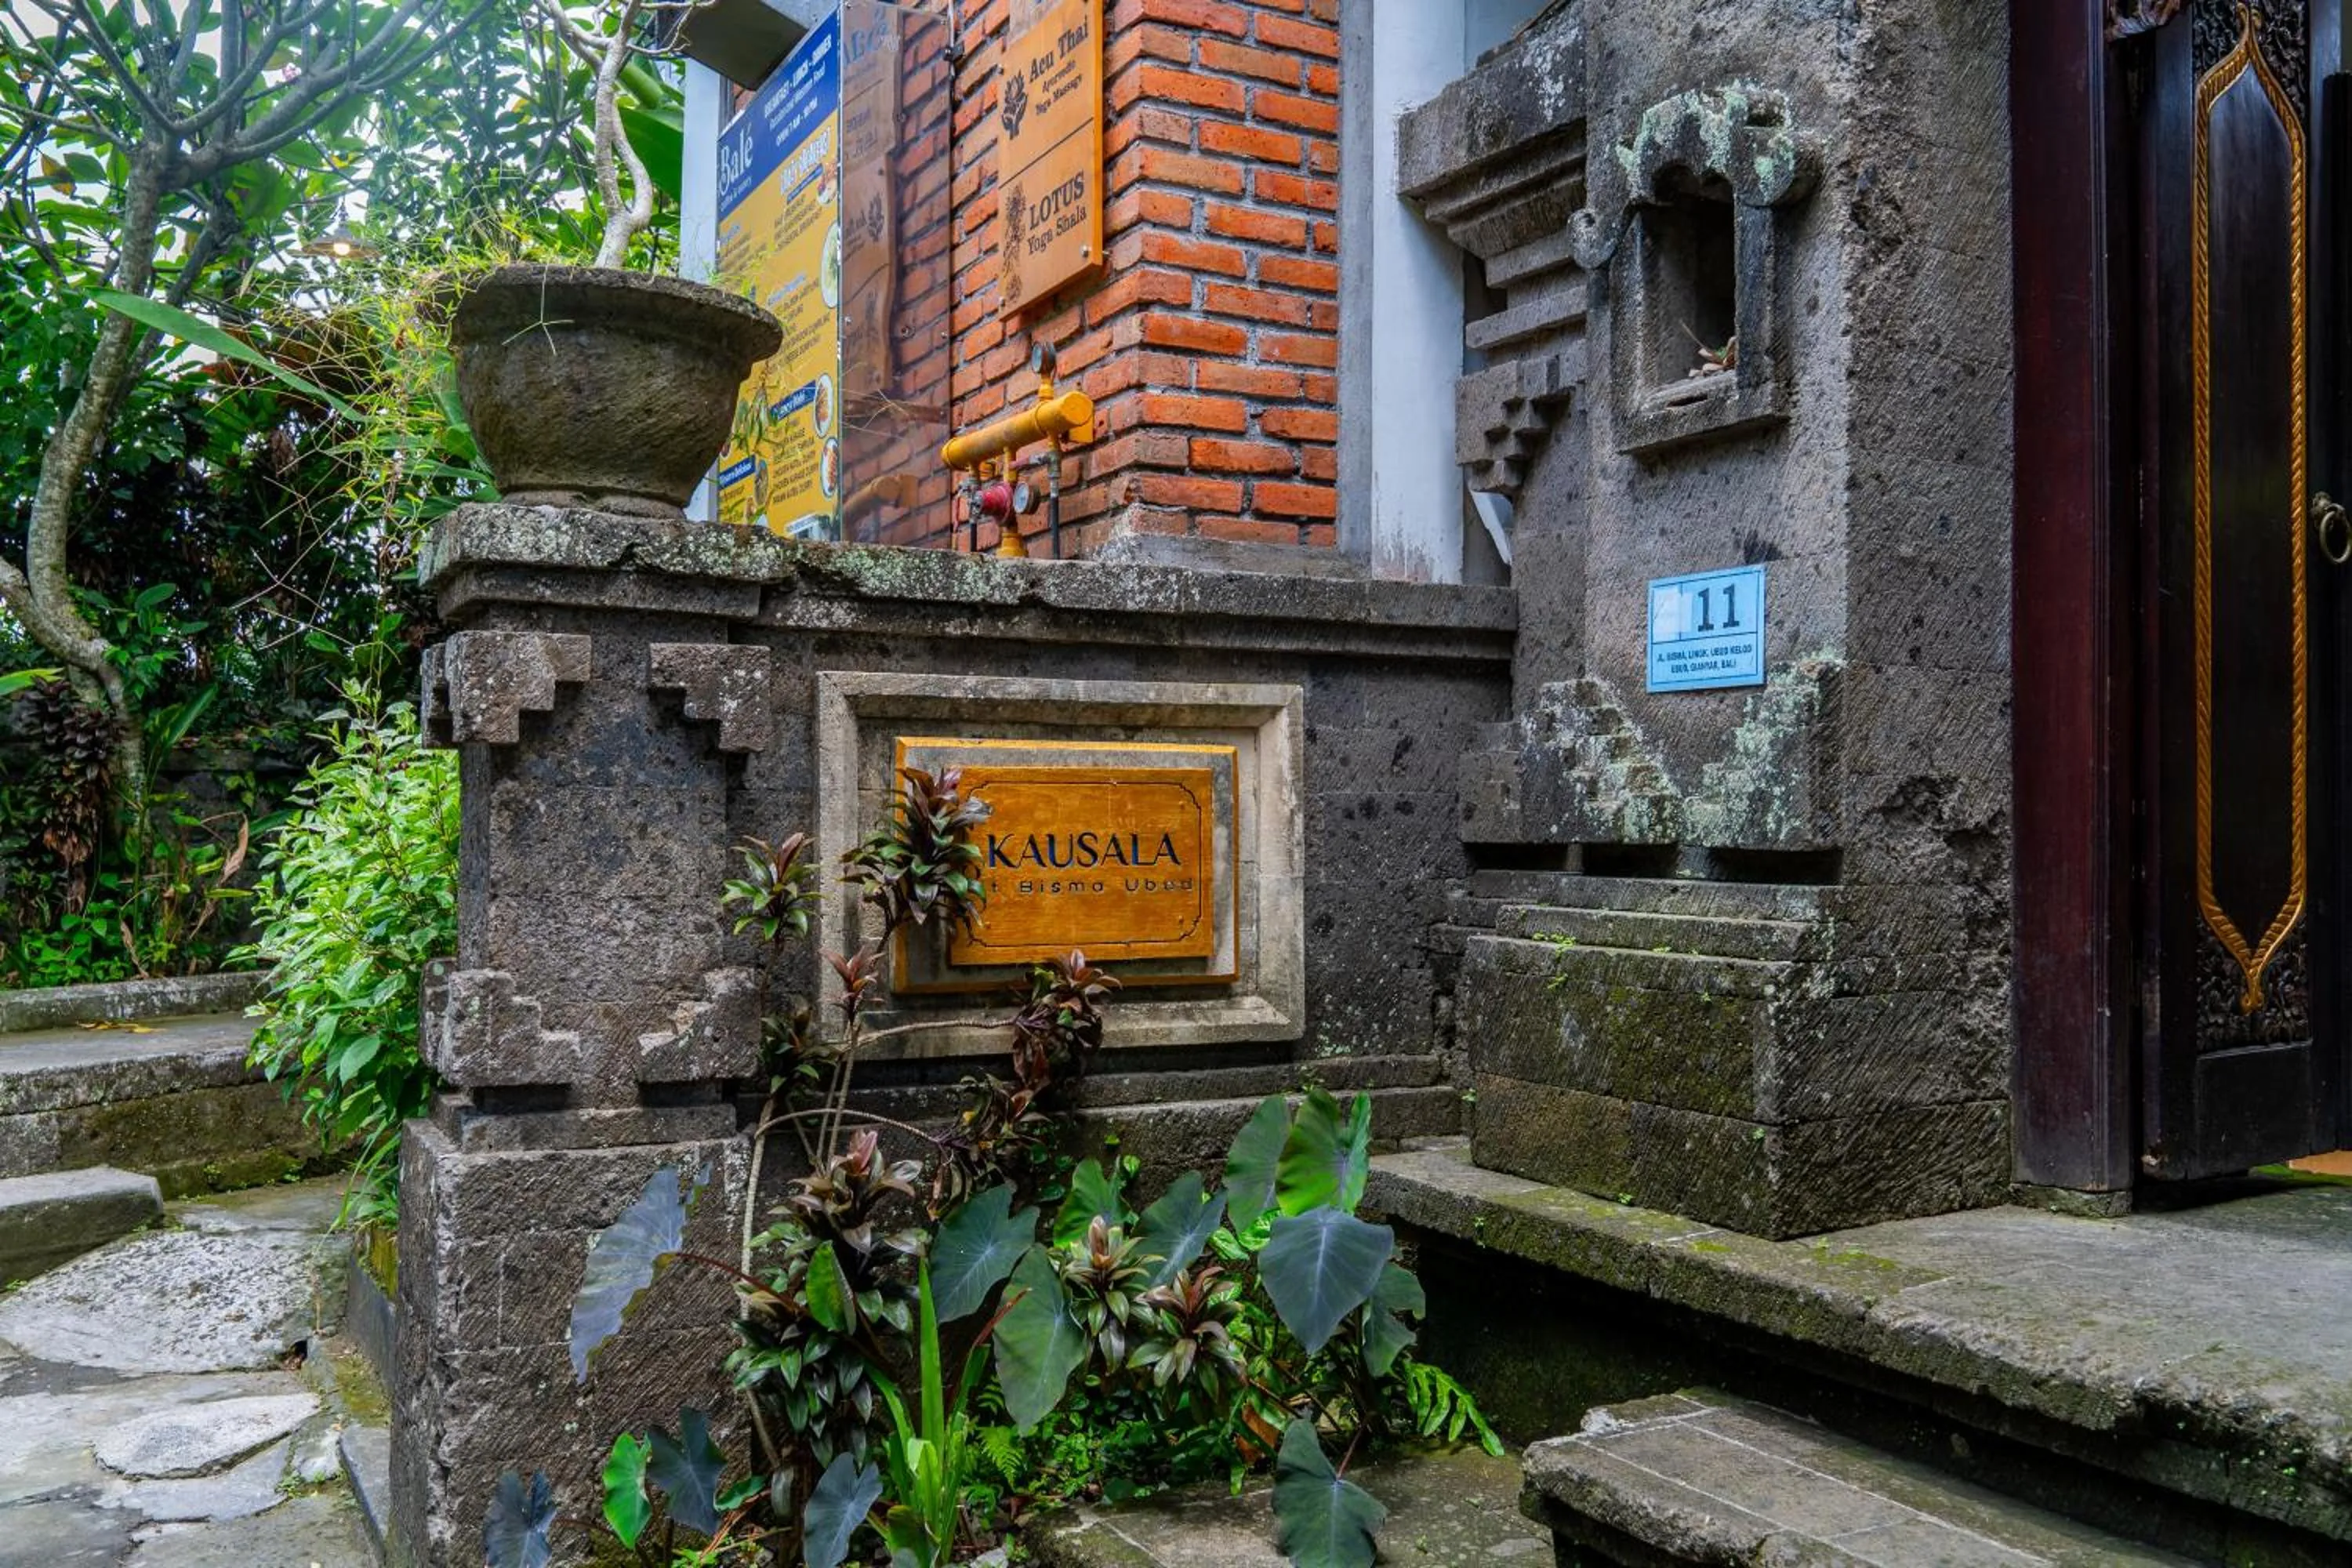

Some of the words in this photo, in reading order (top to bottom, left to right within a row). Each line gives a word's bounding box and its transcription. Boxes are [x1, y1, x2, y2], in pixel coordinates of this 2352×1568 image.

[1029, 50, 1054, 83] Acu
[1058, 15, 1088, 59] Thai
[719, 122, 753, 196] Balé
[1029, 169, 1085, 230] LOTUS
[1027, 229, 1054, 256] Yoga
[1056, 205, 1087, 236] Shala
[1697, 583, 1740, 633] 11
[988, 833, 1182, 869] KAUSALA
[1019, 879, 1105, 894] Bisma
